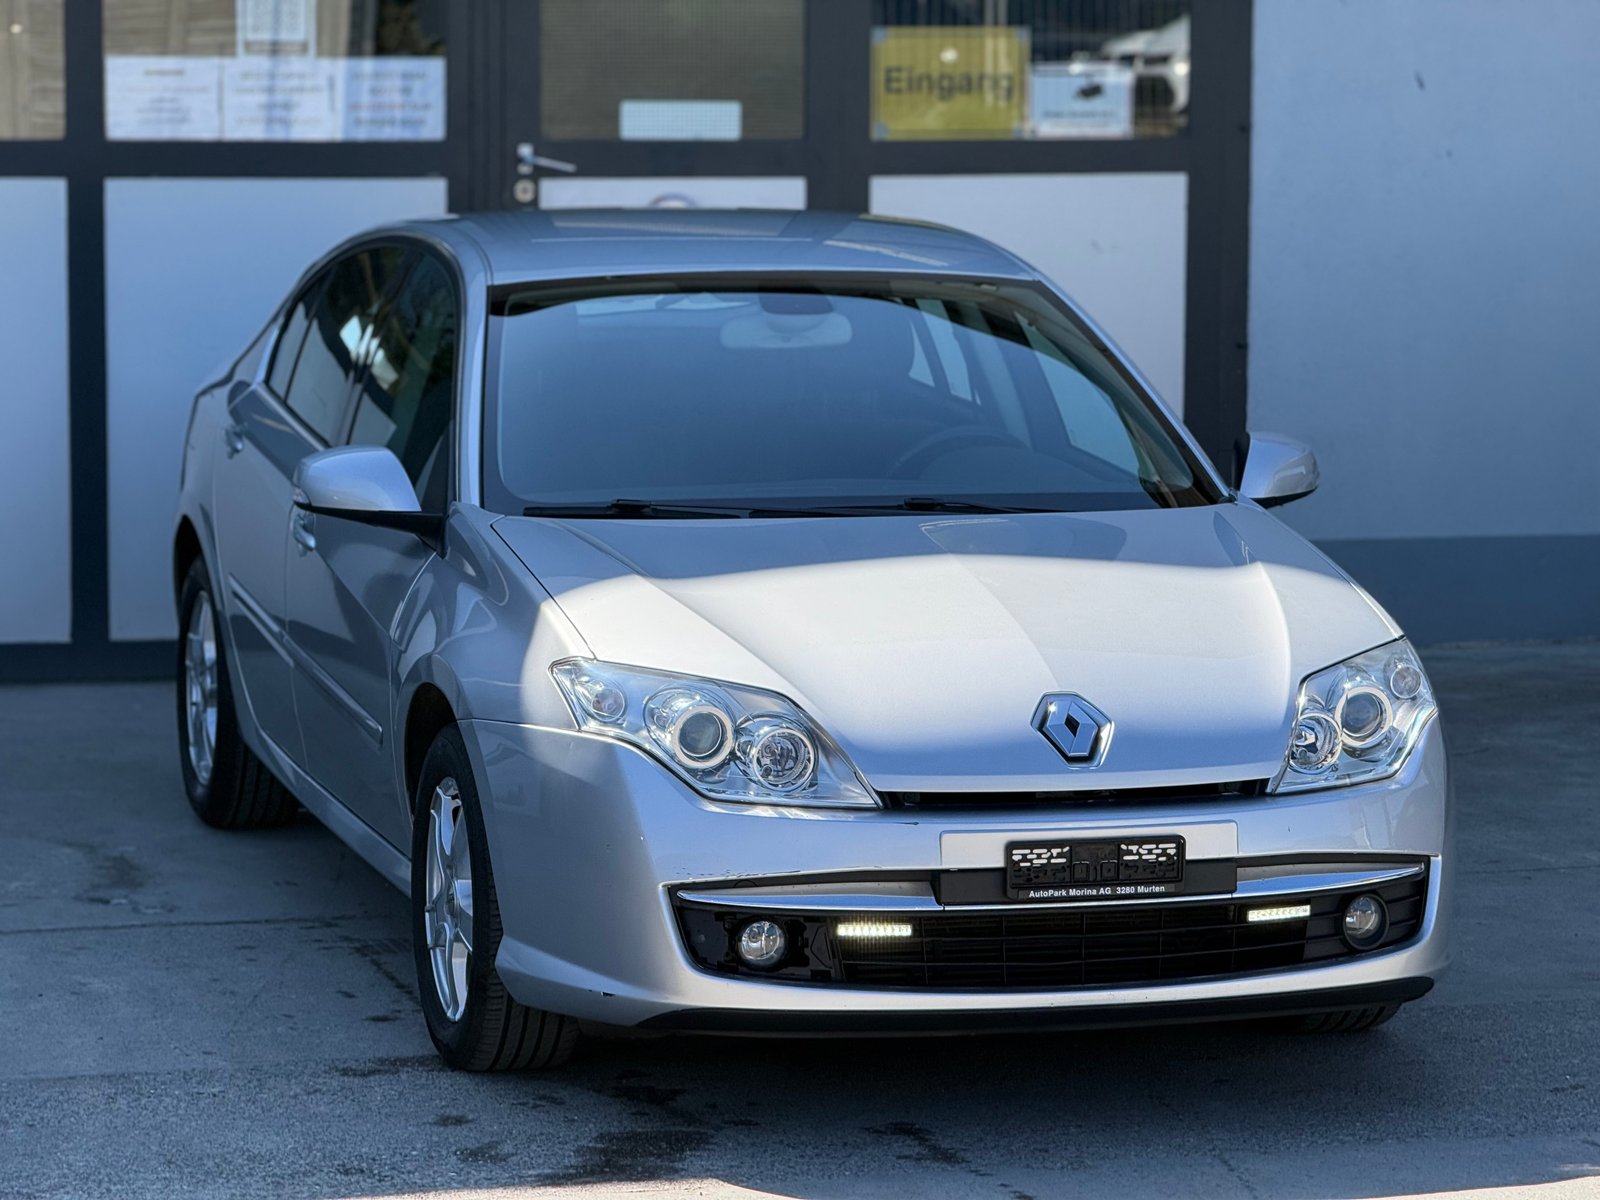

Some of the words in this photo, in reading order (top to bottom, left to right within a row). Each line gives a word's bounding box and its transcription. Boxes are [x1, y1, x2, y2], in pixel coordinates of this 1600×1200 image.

[884, 65, 1014, 104] Eingang
[1029, 889, 1067, 898] AutoPark
[1069, 888, 1097, 896] Morina
[1099, 887, 1112, 895] AG
[1116, 886, 1135, 894] 3280
[1137, 885, 1165, 893] Murten
